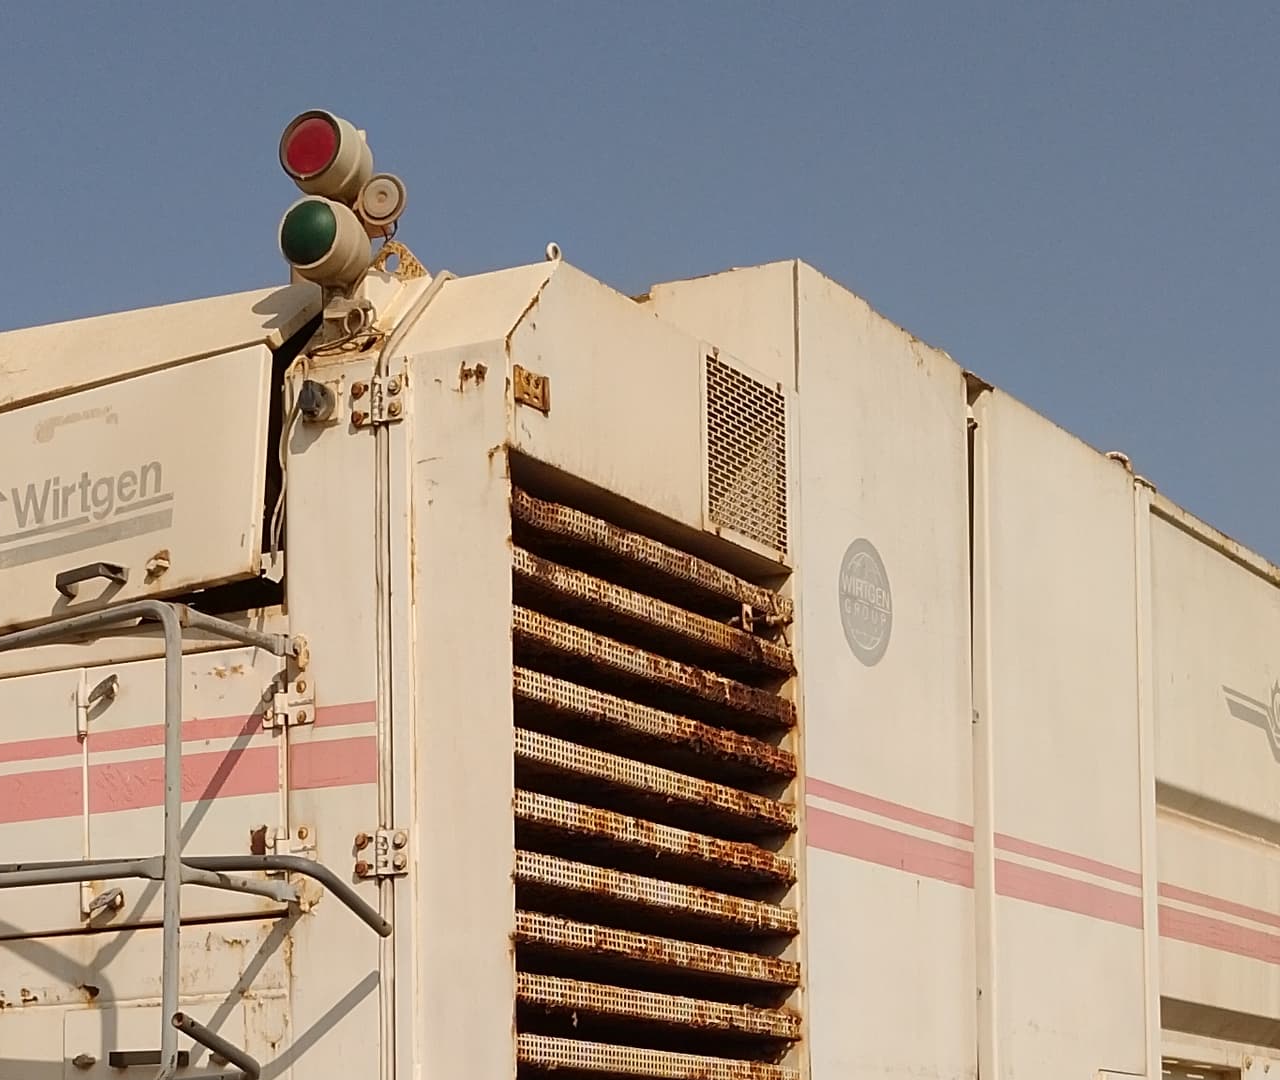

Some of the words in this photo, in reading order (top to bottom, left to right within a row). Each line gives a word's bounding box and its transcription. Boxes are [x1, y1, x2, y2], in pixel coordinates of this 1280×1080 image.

[11, 460, 162, 529] Wirtgen
[841, 572, 891, 611] WIRTGEN
[844, 599, 887, 625] GROUP
